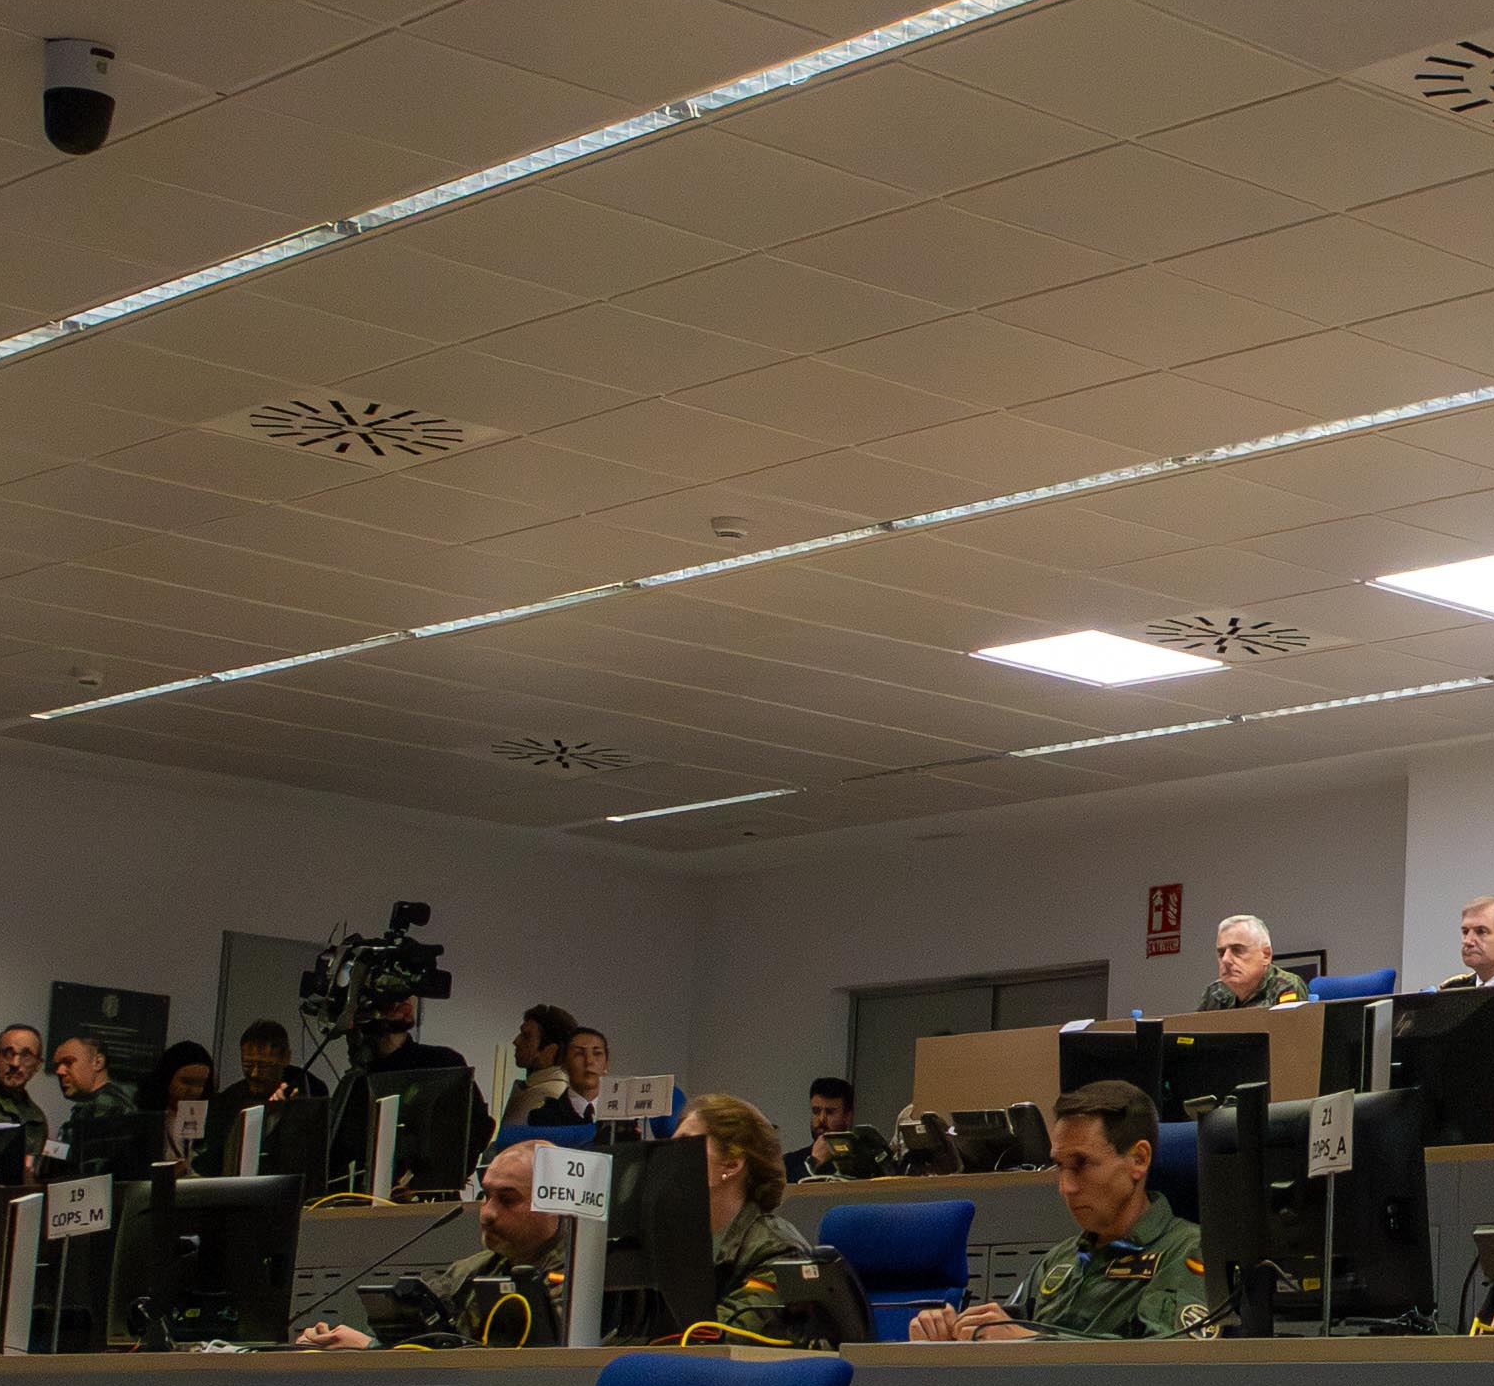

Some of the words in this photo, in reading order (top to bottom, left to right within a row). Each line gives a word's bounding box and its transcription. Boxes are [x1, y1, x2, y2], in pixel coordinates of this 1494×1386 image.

[640, 1082, 652, 1094] 10
[1321, 1105, 1333, 1127] 21
[566, 1160, 585, 1178] 20
[70, 1187, 85, 1203] 19
[537, 1185, 605, 1208] OFEN_JFAC
[51, 1208, 104, 1228] COPS_M
